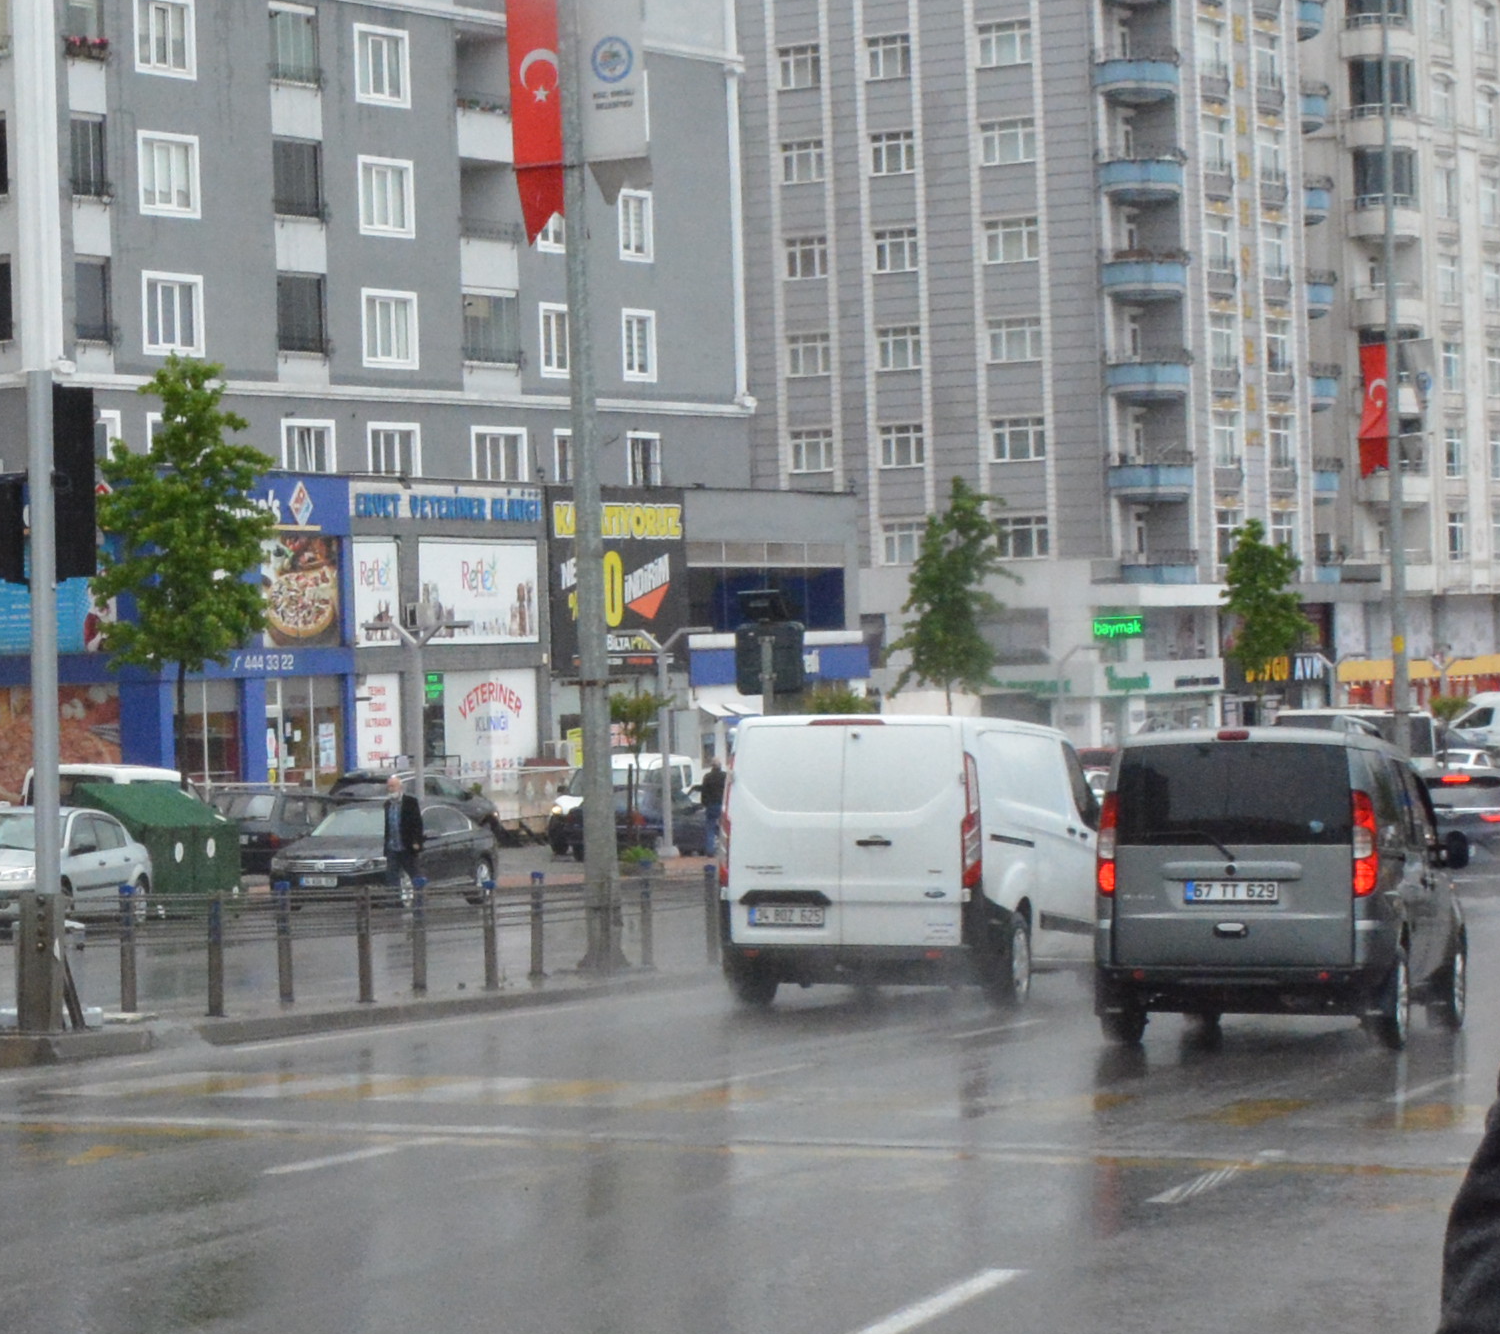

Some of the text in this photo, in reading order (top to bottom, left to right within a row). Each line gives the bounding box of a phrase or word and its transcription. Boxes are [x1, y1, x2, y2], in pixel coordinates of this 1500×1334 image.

[1094, 619, 1142, 637] baymak
[245, 654, 294, 670] 444 33 22
[458, 678, 522, 720] VETERİNER
[1194, 883, 1275, 898] 67 TT 629
